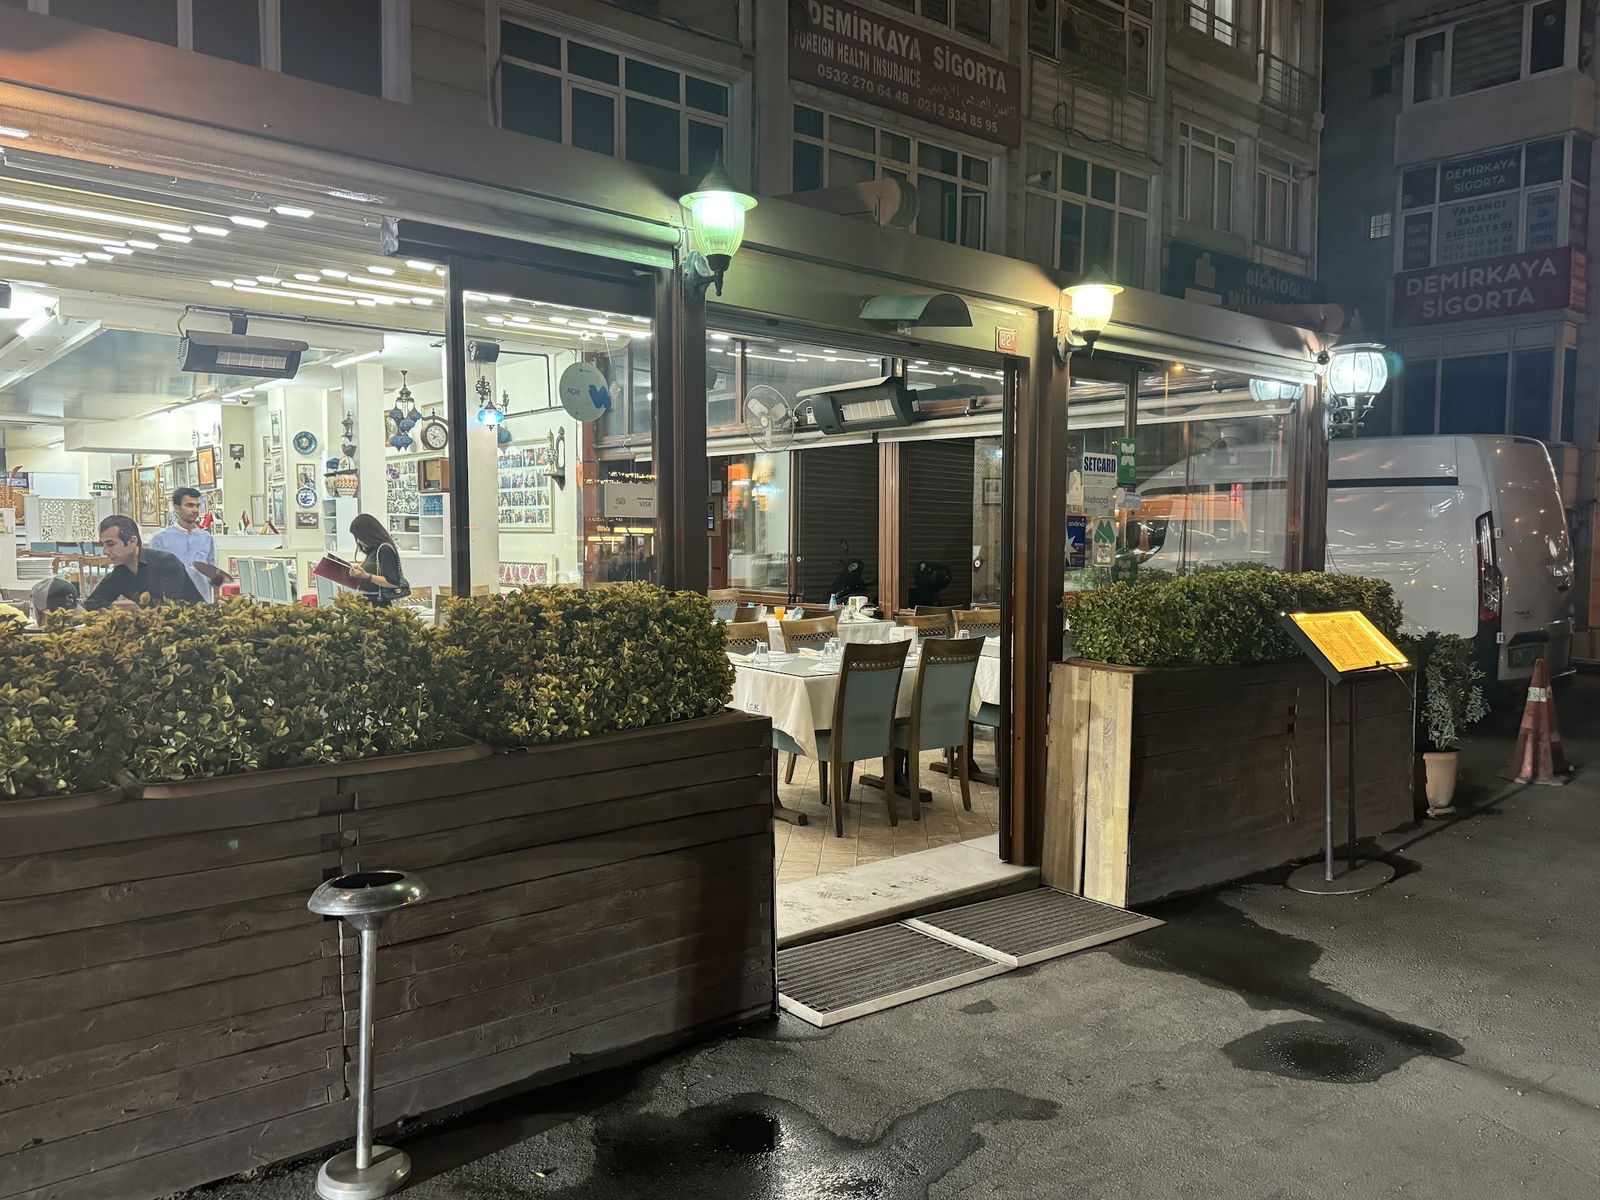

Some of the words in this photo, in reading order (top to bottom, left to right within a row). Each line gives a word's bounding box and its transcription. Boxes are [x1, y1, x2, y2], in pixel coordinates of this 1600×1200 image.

[794, 30, 834, 60] FOREIGN
[837, 40, 870, 72] HEALTH
[873, 56, 921, 89] INSURANCE
[933, 45, 1008, 94] SİGORTA
[817, 64, 849, 86] 0532
[852, 75, 874, 93] 270
[877, 84, 891, 98] 64
[896, 90, 909, 105] 48
[918, 97, 944, 117] 0212
[948, 107, 967, 125] 534
[970, 115, 983, 129] 85
[985, 119, 998, 134] 95
[1406, 257, 1557, 296] DEMİRKAYA
[1422, 286, 1535, 318] SİGORTA
[1084, 456, 1116, 473] SETCARD
